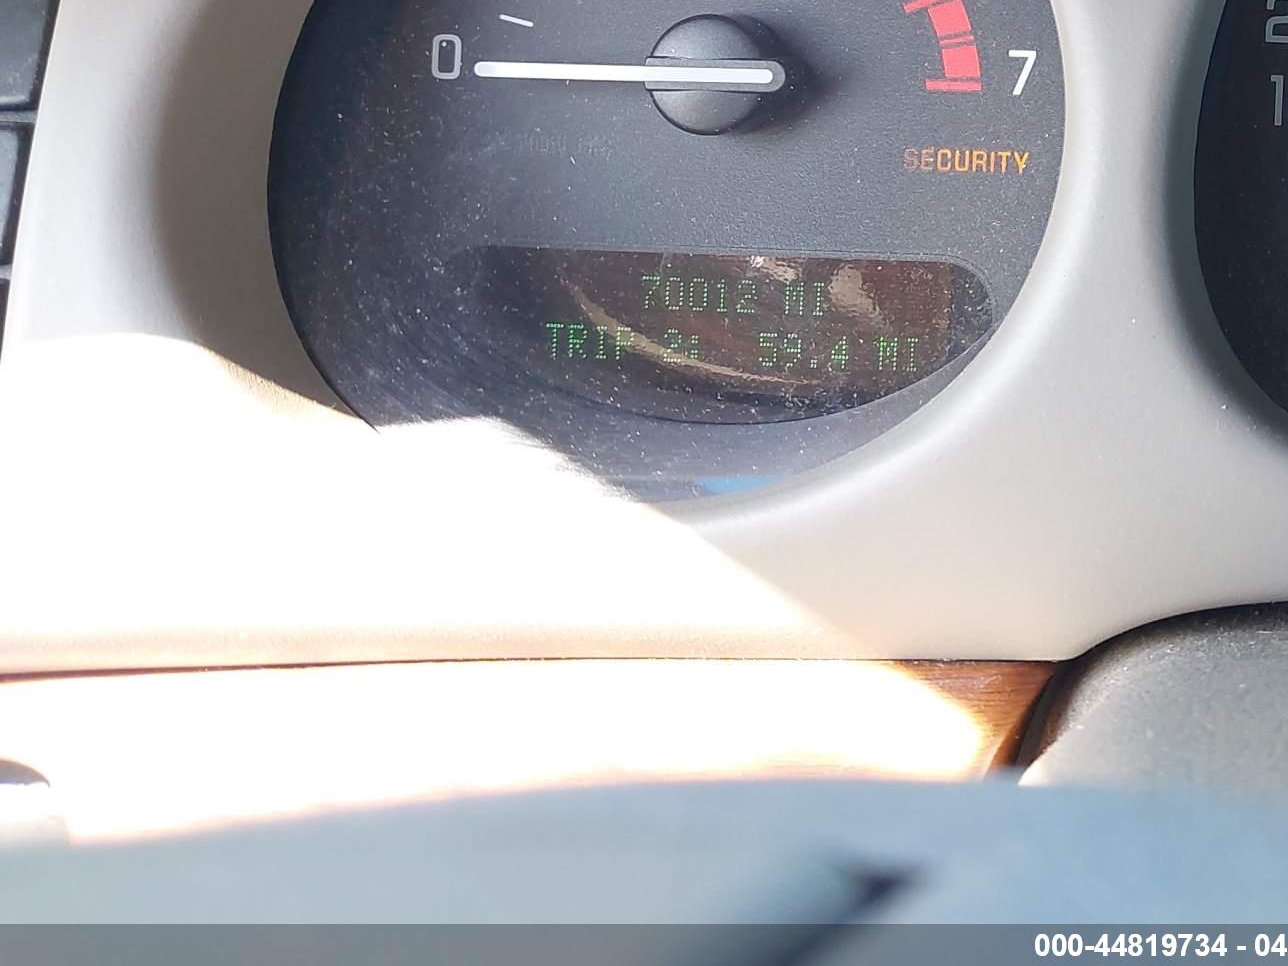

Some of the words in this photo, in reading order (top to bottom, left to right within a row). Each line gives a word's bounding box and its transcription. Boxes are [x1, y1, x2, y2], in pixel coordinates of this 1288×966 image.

[432, 34, 462, 80] 0
[1008, 50, 1037, 96] 7
[903, 146, 1029, 174] SECURITY
[642, 276, 756, 314] 70012
[785, 282, 825, 316] MI
[546, 323, 634, 361] TRIP
[875, 337, 919, 372] MI
